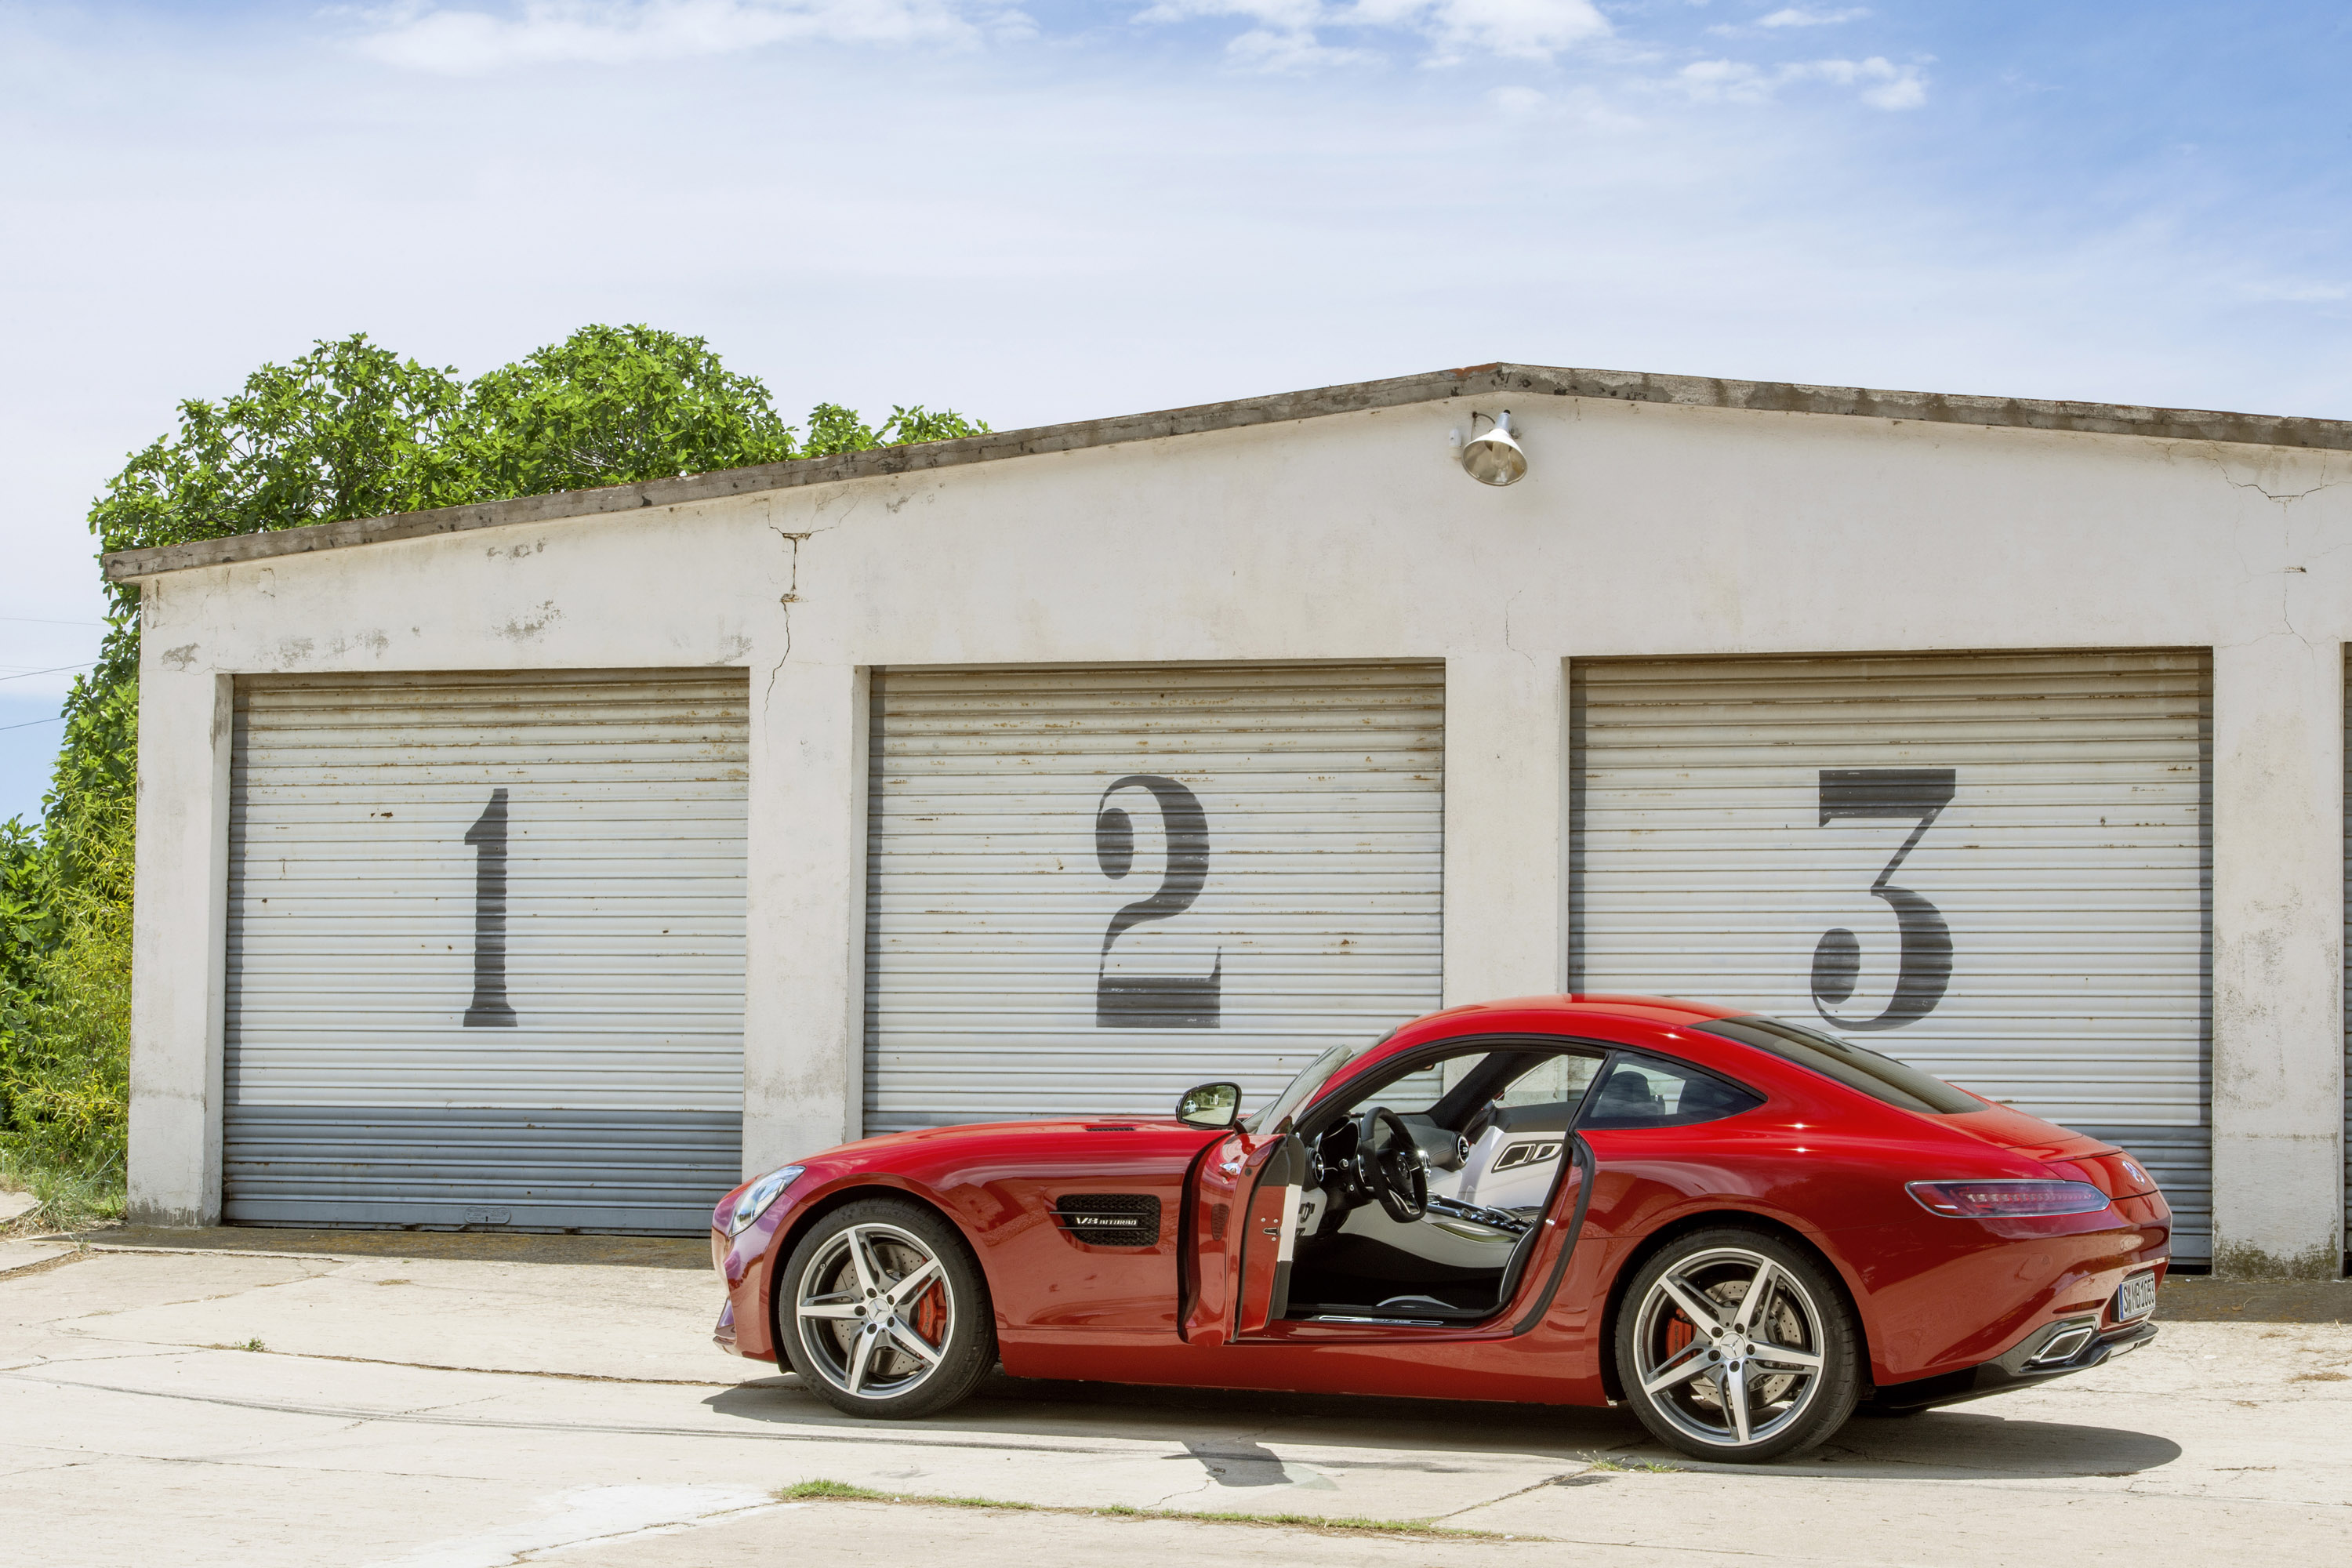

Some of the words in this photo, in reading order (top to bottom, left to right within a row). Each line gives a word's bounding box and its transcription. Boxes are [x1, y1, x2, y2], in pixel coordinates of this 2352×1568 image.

[463, 788, 517, 1027] 1
[1095, 775, 1221, 1029] 2
[1811, 768, 1956, 1031] 3
